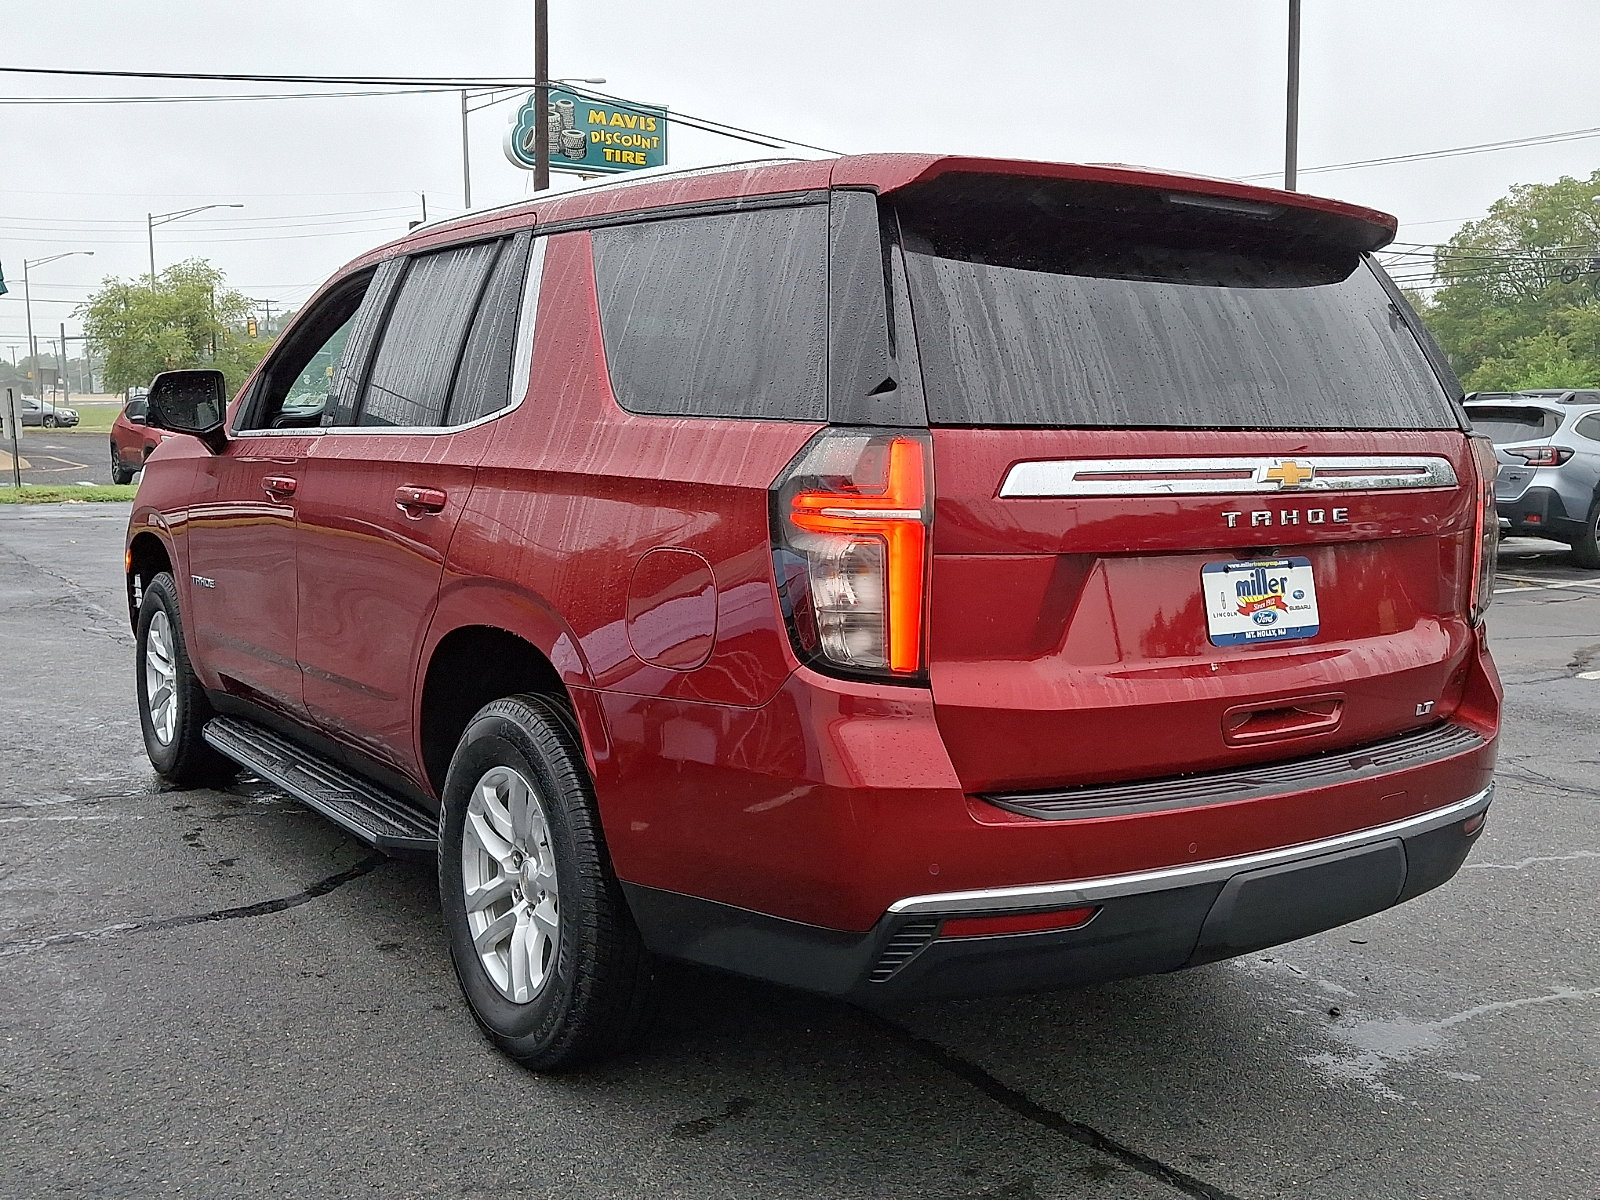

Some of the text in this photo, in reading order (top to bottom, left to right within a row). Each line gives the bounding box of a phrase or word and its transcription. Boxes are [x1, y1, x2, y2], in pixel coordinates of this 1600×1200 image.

[588, 110, 657, 132] MAVIS
[591, 130, 660, 149] DISCOUNT
[602, 148, 646, 165] TIRE
[1221, 508, 1349, 528] TAHOE
[1236, 568, 1288, 597] miller
[1257, 614, 1274, 623] Ford
[1278, 628, 1287, 636] NJ
[1416, 701, 1435, 716] LT
